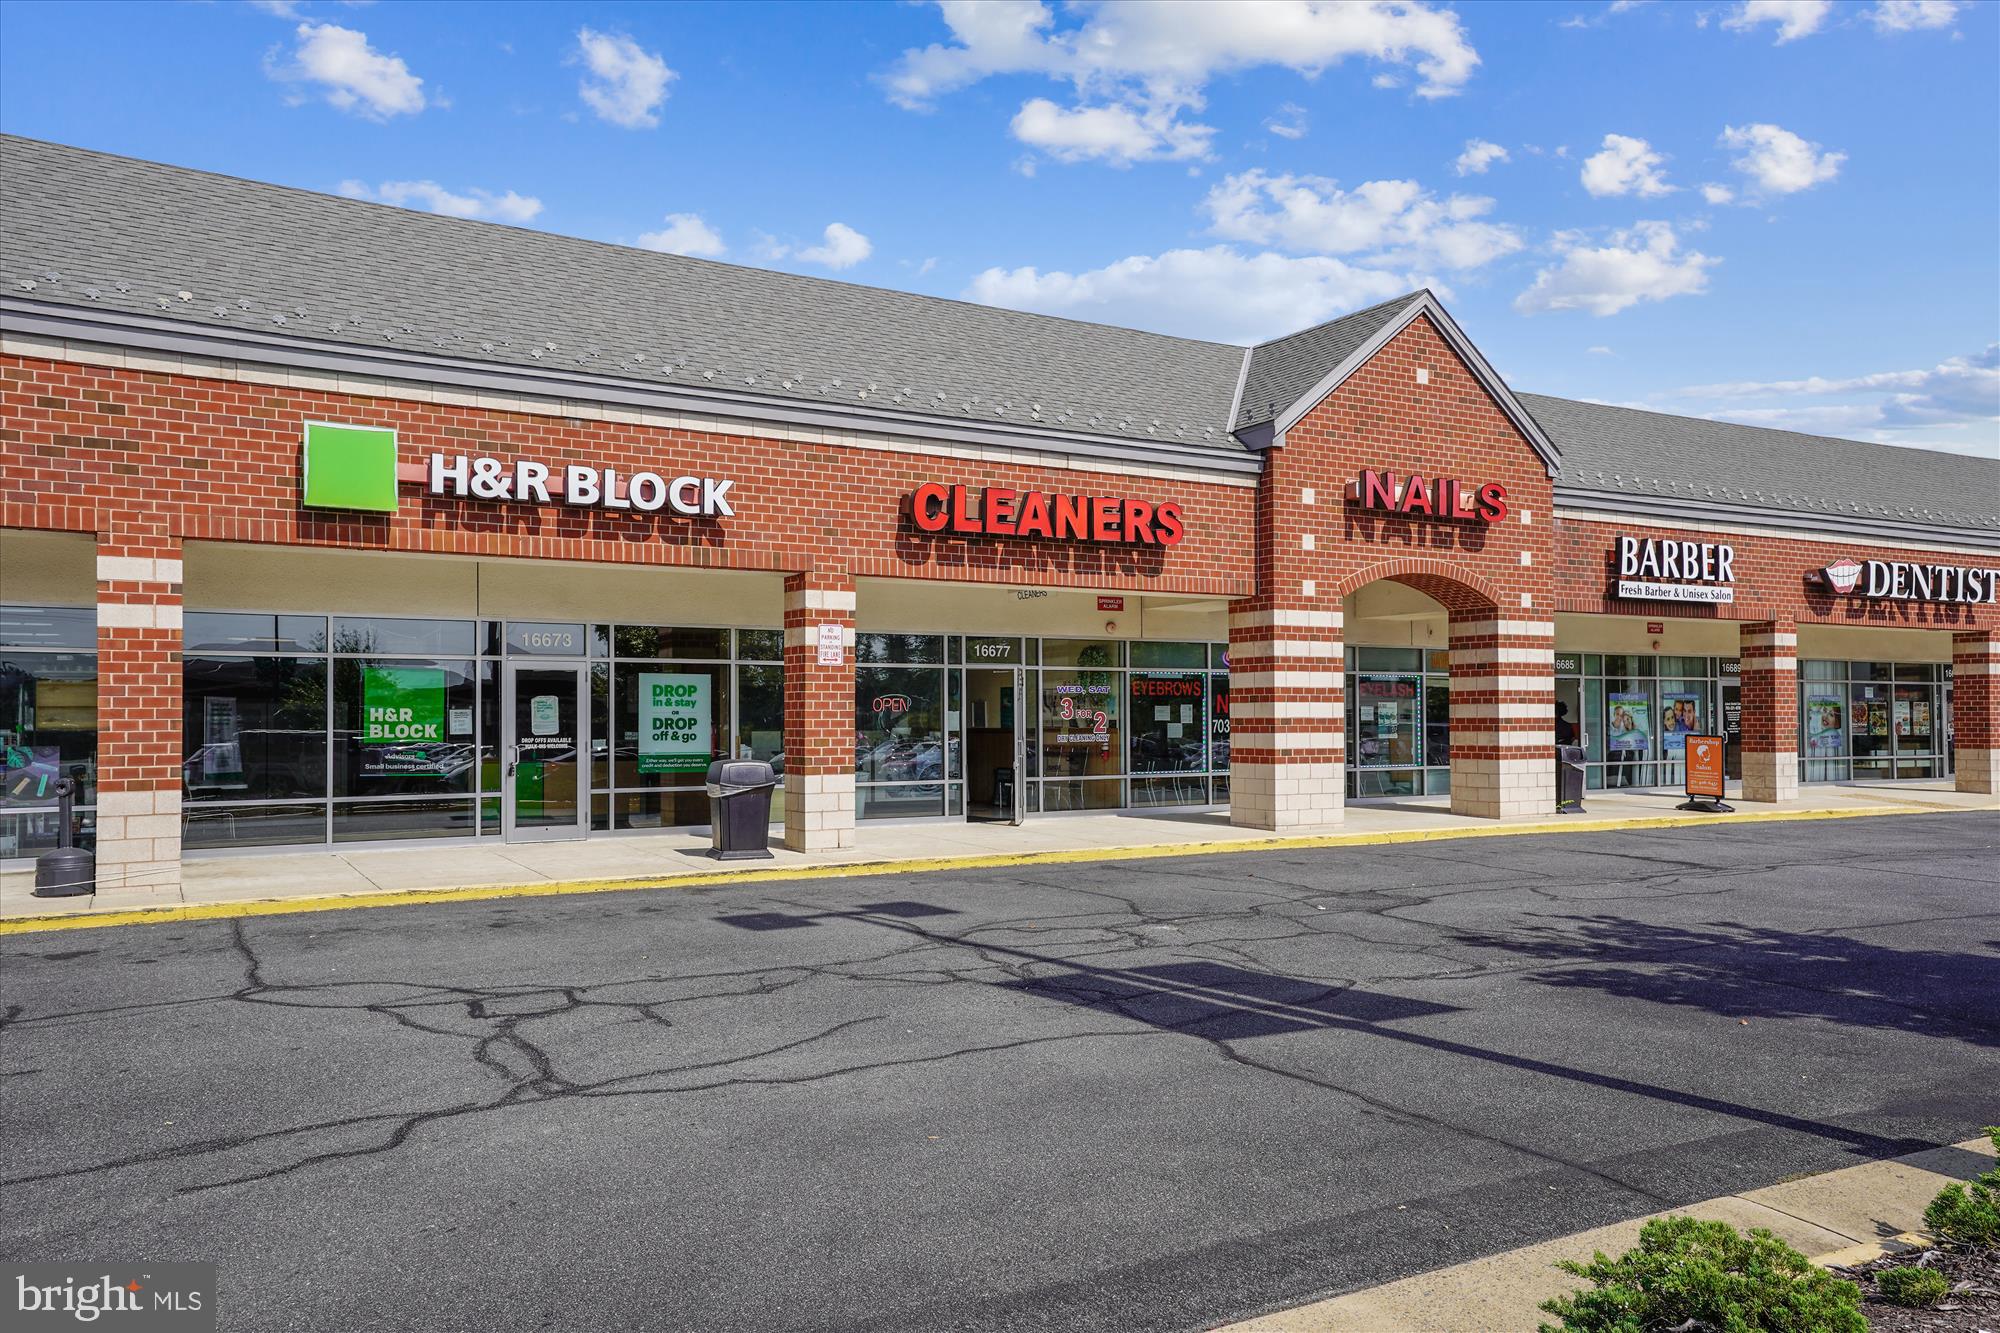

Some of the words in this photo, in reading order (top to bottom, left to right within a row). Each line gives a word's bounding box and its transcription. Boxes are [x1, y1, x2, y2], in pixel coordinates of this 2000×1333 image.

[430, 452, 550, 502] H&R
[567, 464, 736, 517] BLOCK
[1361, 468, 1508, 522] NAILS
[912, 482, 1185, 546] CLEANERS
[1620, 536, 1736, 582] BARBER
[1866, 559, 2000, 604] DENTIST
[1620, 584, 1642, 596] Fresh
[1645, 586, 1671, 598] Barber
[1673, 588, 1680, 598] &
[1682, 588, 1709, 600] Unisex
[1710, 590, 1732, 601] Salon
[522, 632, 572, 647] 16673
[974, 644, 1011, 657] 16677
[1553, 659, 1575, 670] 6685
[1722, 663, 1741, 672] 16689
[652, 684, 698, 697] DROP
[1057, 685, 1086, 694] WED,
[1089, 685, 1111, 694] SAT
[1132, 681, 1202, 696] EYEBROWS
[1359, 683, 1415, 697] EYELASH
[652, 698, 663, 707] in
[664, 698, 673, 707] &
[675, 698, 697, 708] stay
[872, 697, 909, 712] OPEN
[369, 707, 413, 722] H&R
[1060, 697, 1073, 720] 3
[1075, 709, 1092, 719] FOR
[1093, 711, 1107, 733] 2
[369, 724, 438, 738] BLOCK
[652, 717, 698, 730] DROP
[652, 731, 668, 741] off
[670, 731, 680, 741] &
[681, 733, 697, 743] go
